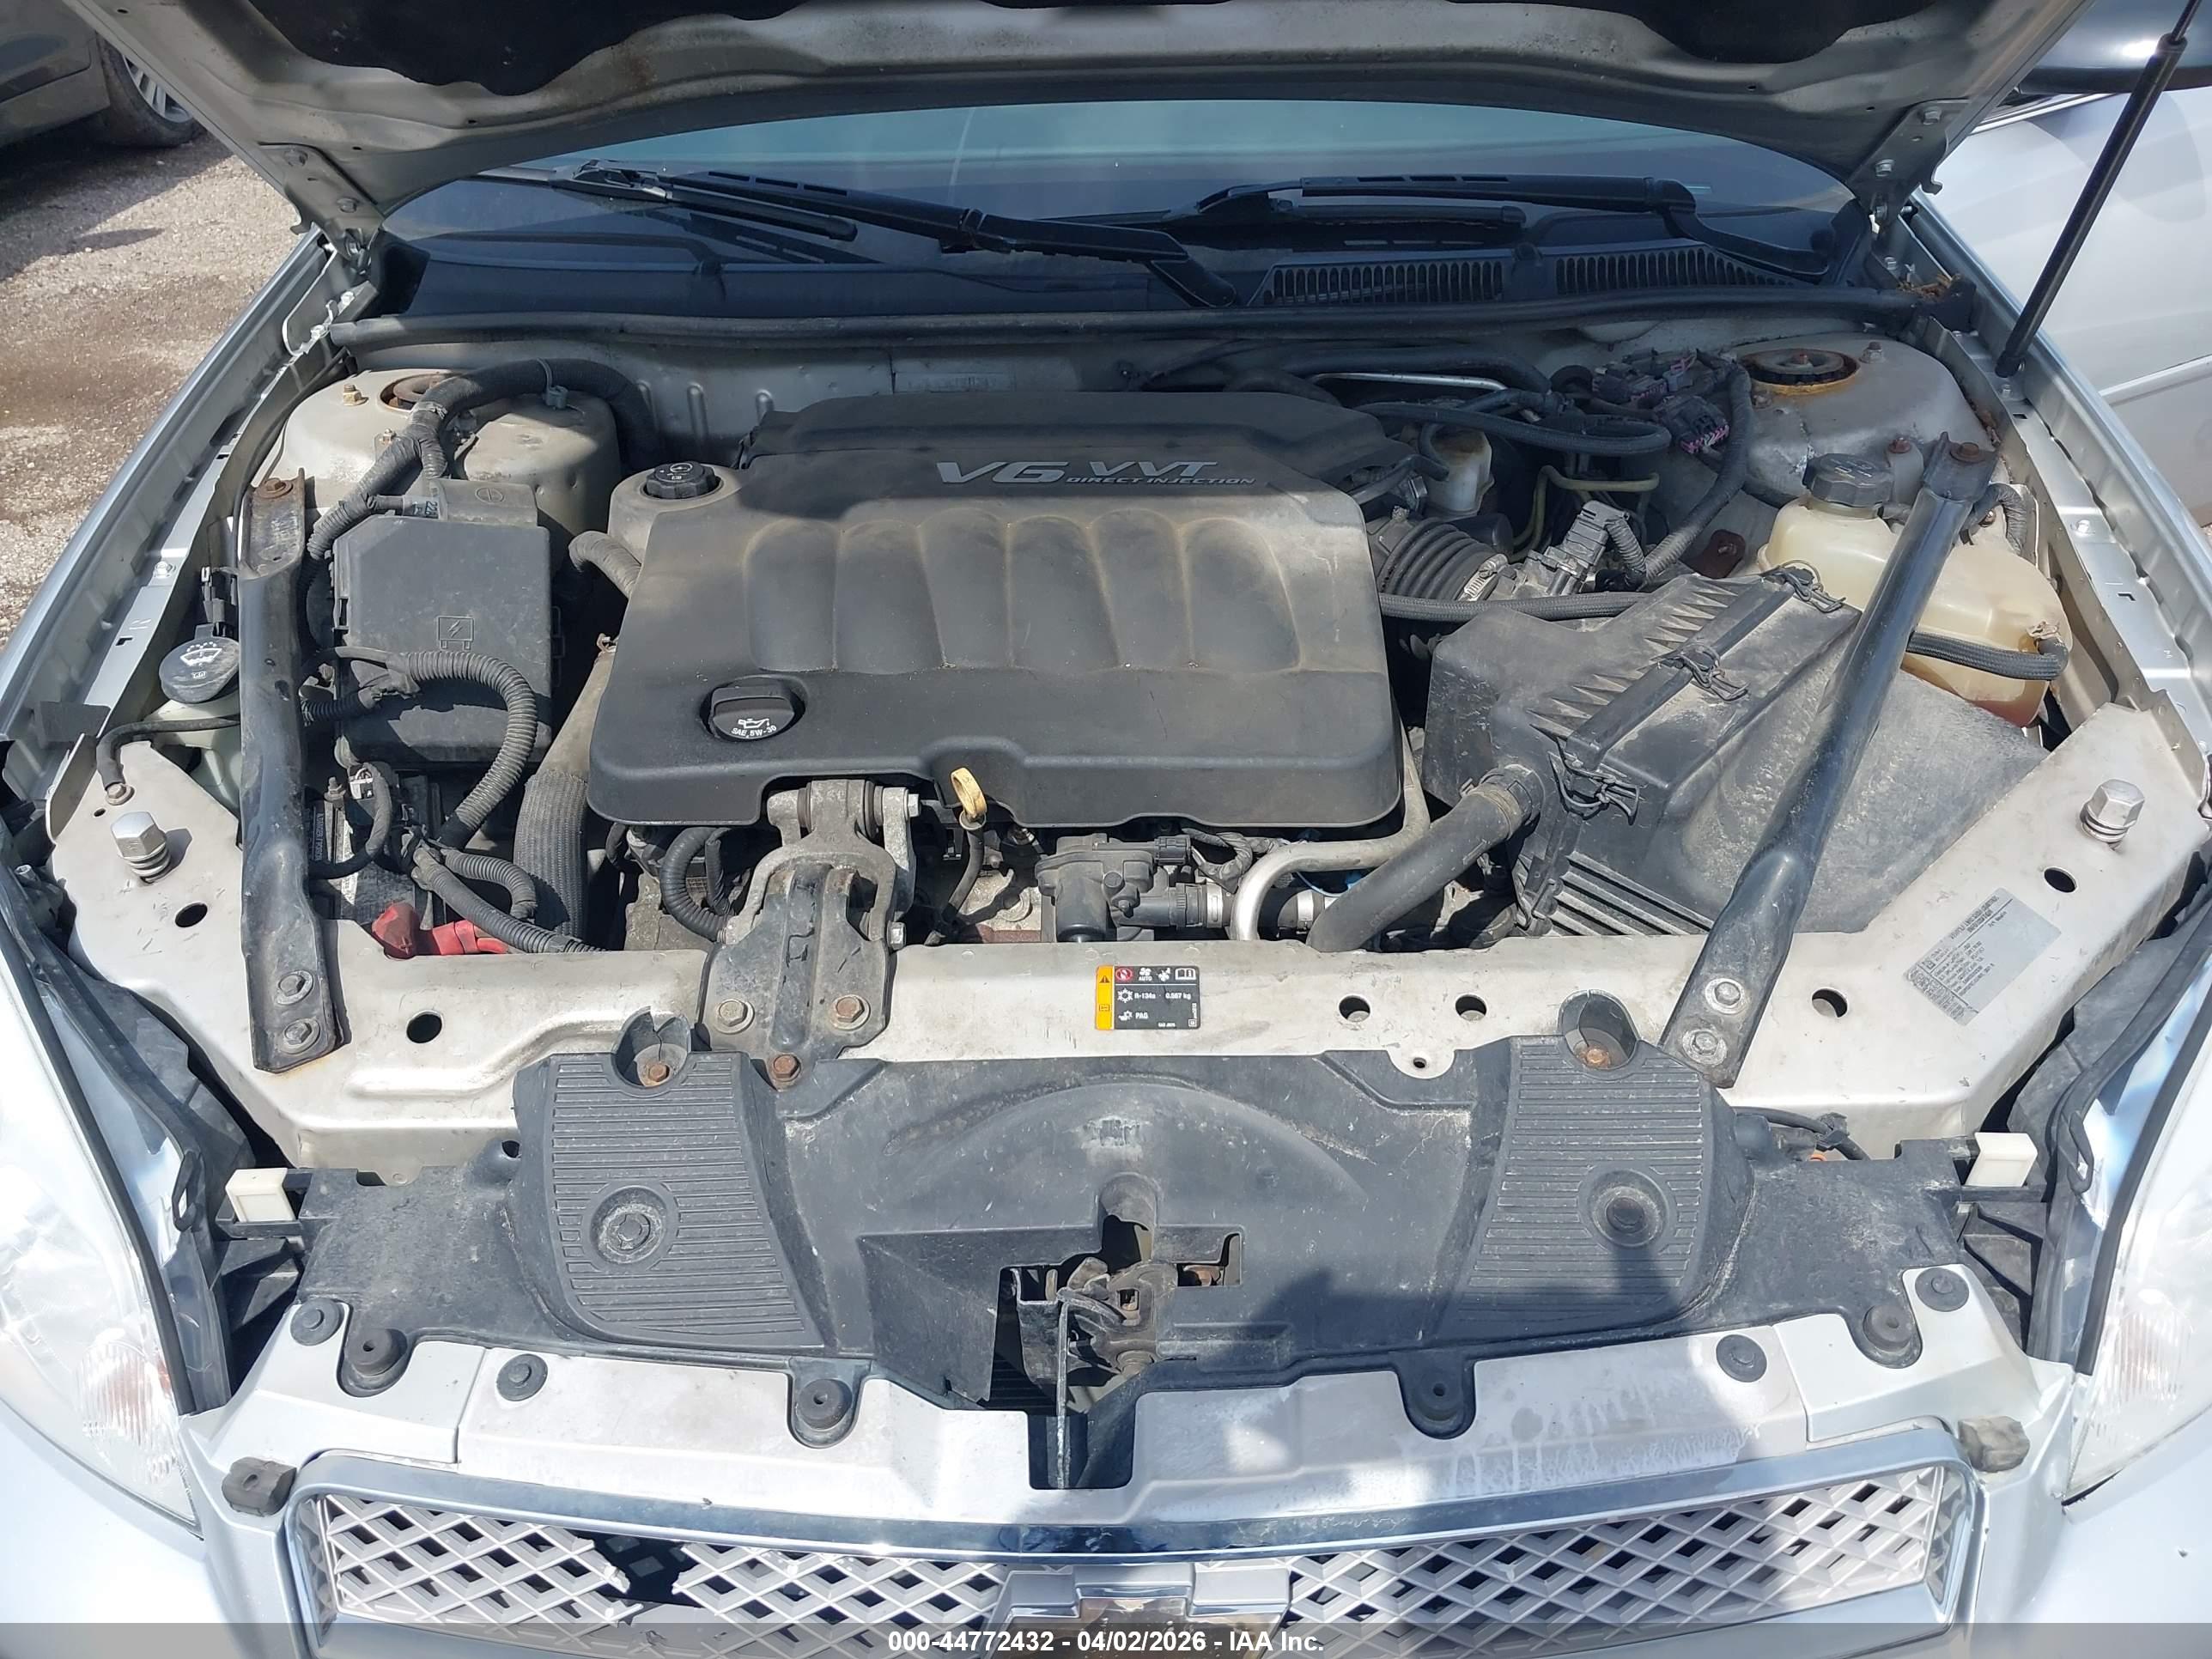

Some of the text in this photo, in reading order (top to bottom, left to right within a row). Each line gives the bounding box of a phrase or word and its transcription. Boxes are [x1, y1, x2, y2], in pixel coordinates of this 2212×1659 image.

[936, 460, 1218, 484] V6 VVT
[1146, 477, 1255, 485] INJECTION
[731, 725, 777, 737] SAE 5W-30
